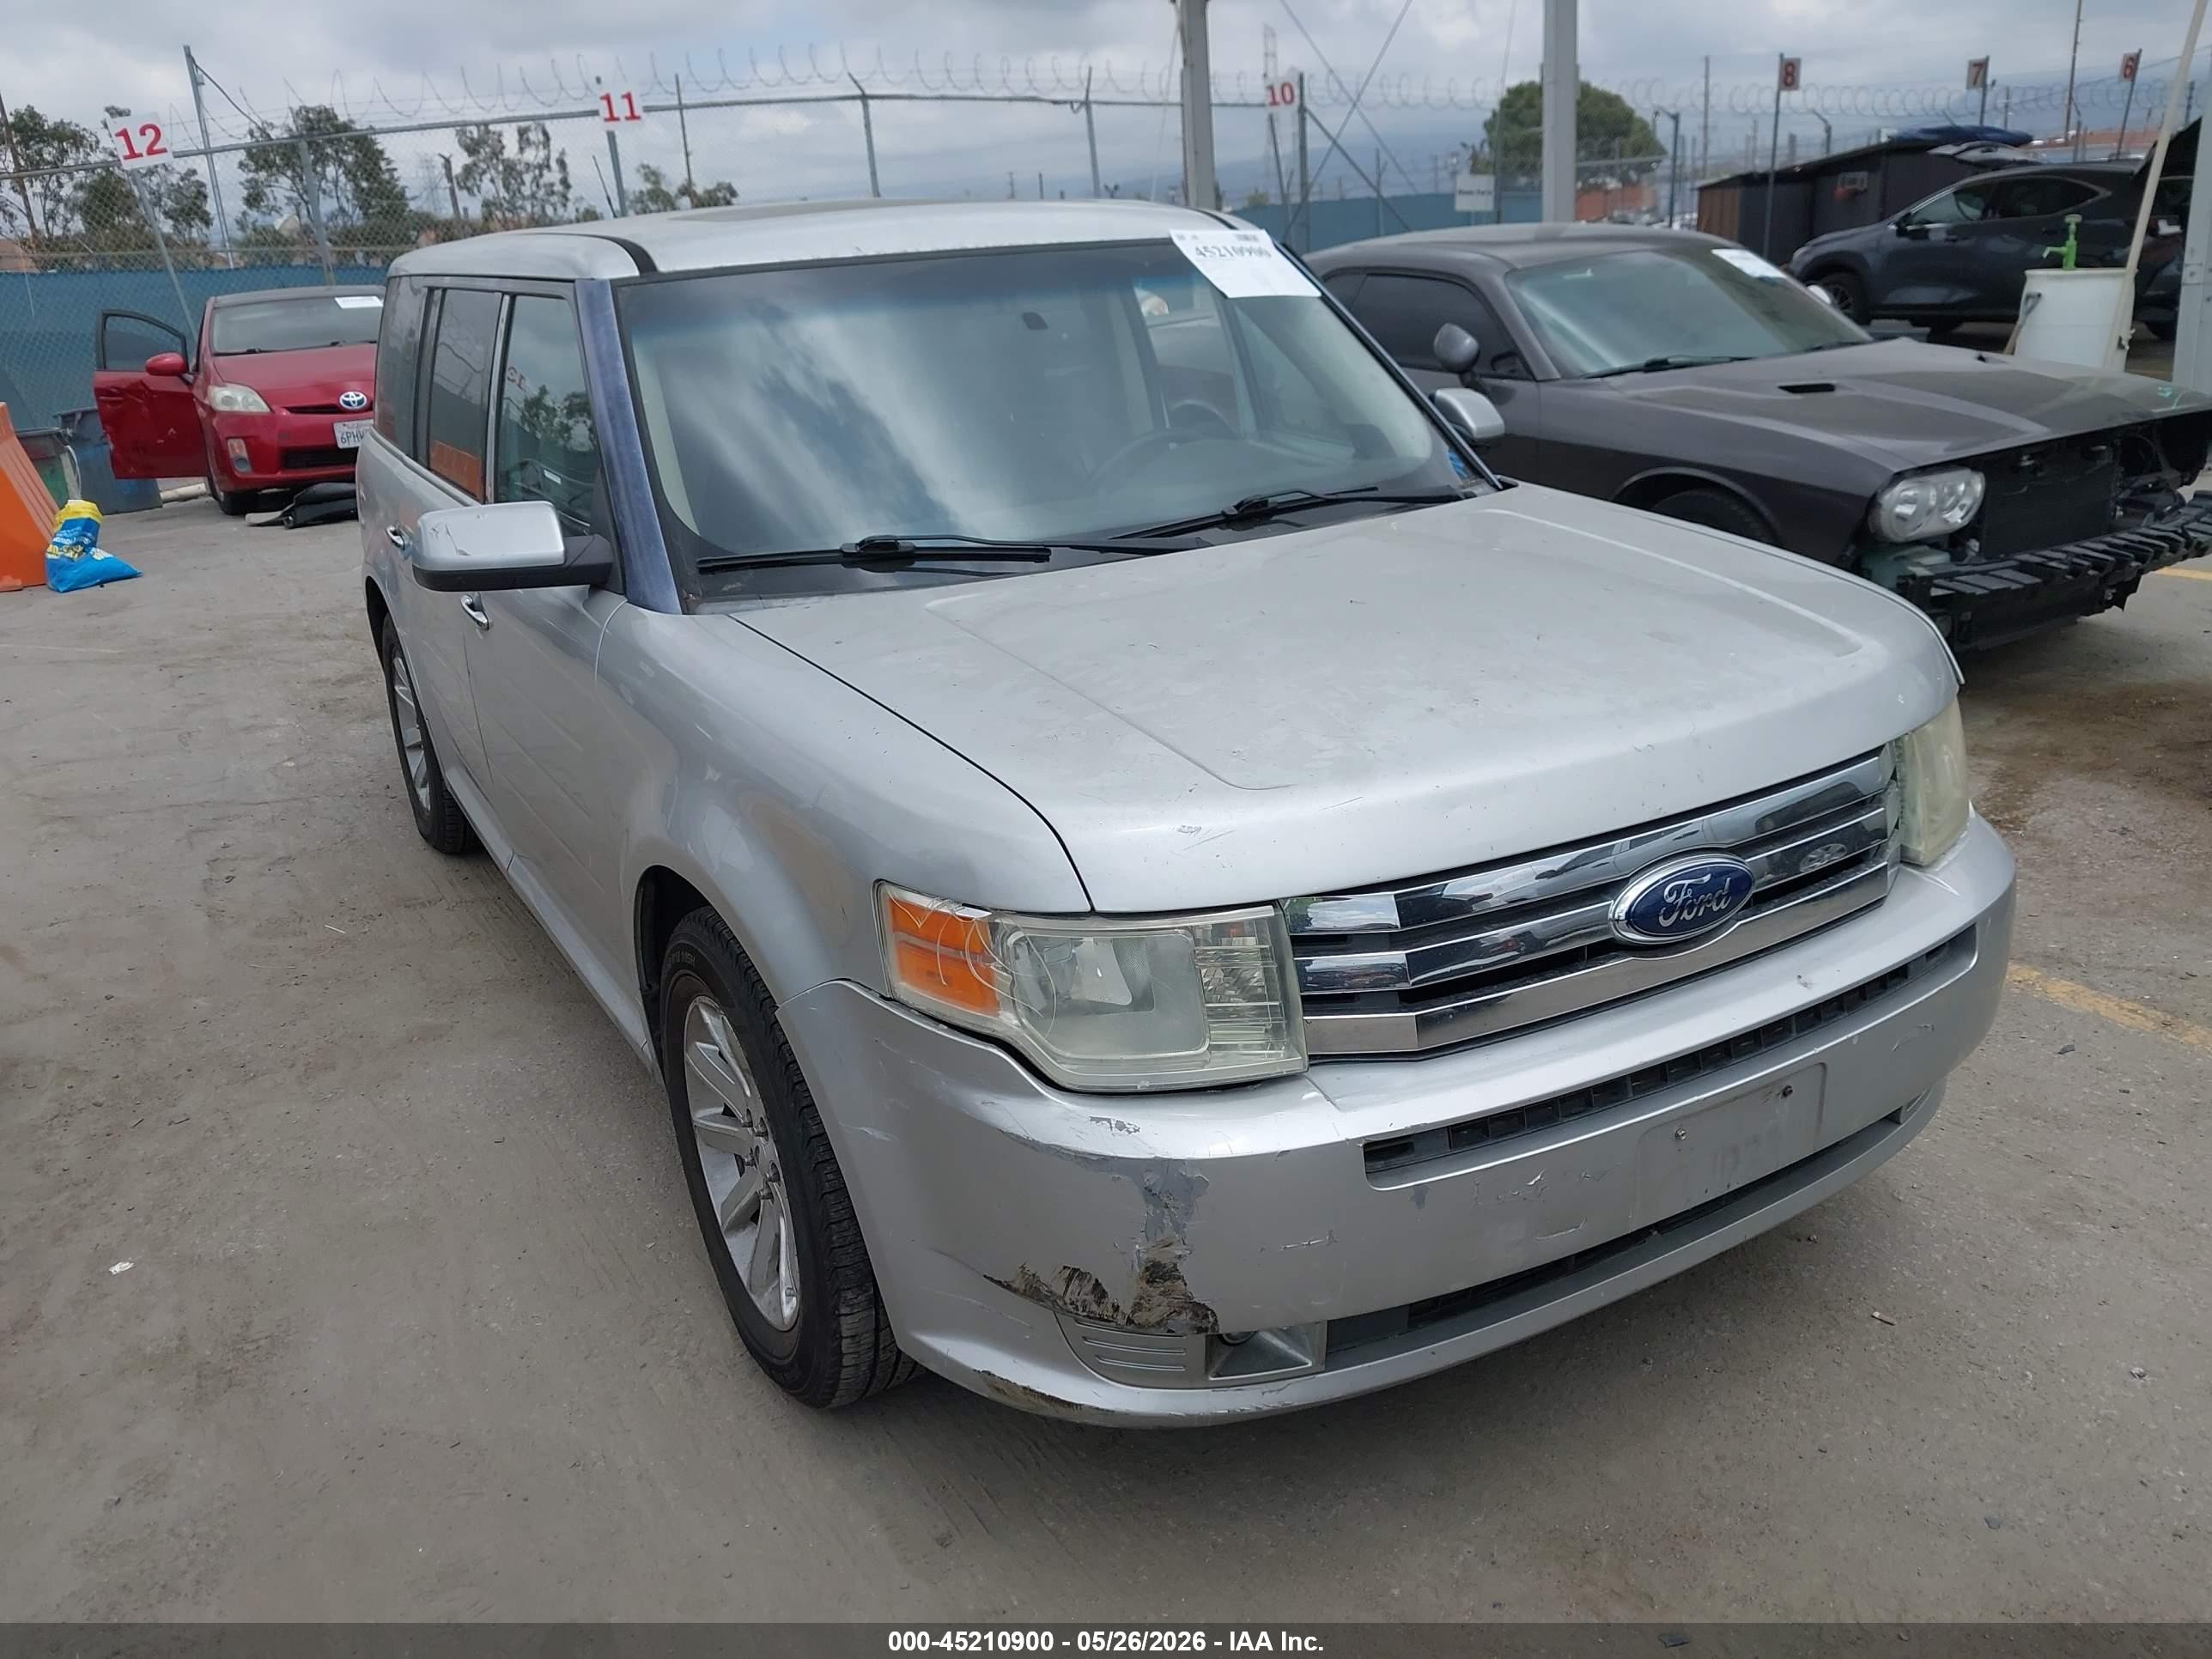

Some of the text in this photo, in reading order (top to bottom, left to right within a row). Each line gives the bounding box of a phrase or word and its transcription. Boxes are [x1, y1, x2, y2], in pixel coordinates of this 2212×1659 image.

[1784, 63, 1795, 87] 8
[1973, 63, 1984, 85] 7
[2124, 57, 2135, 78] 6
[1266, 82, 1294, 106] 10
[600, 92, 641, 122] 11
[115, 123, 167, 161] 12
[1658, 873, 1731, 927] Ford
